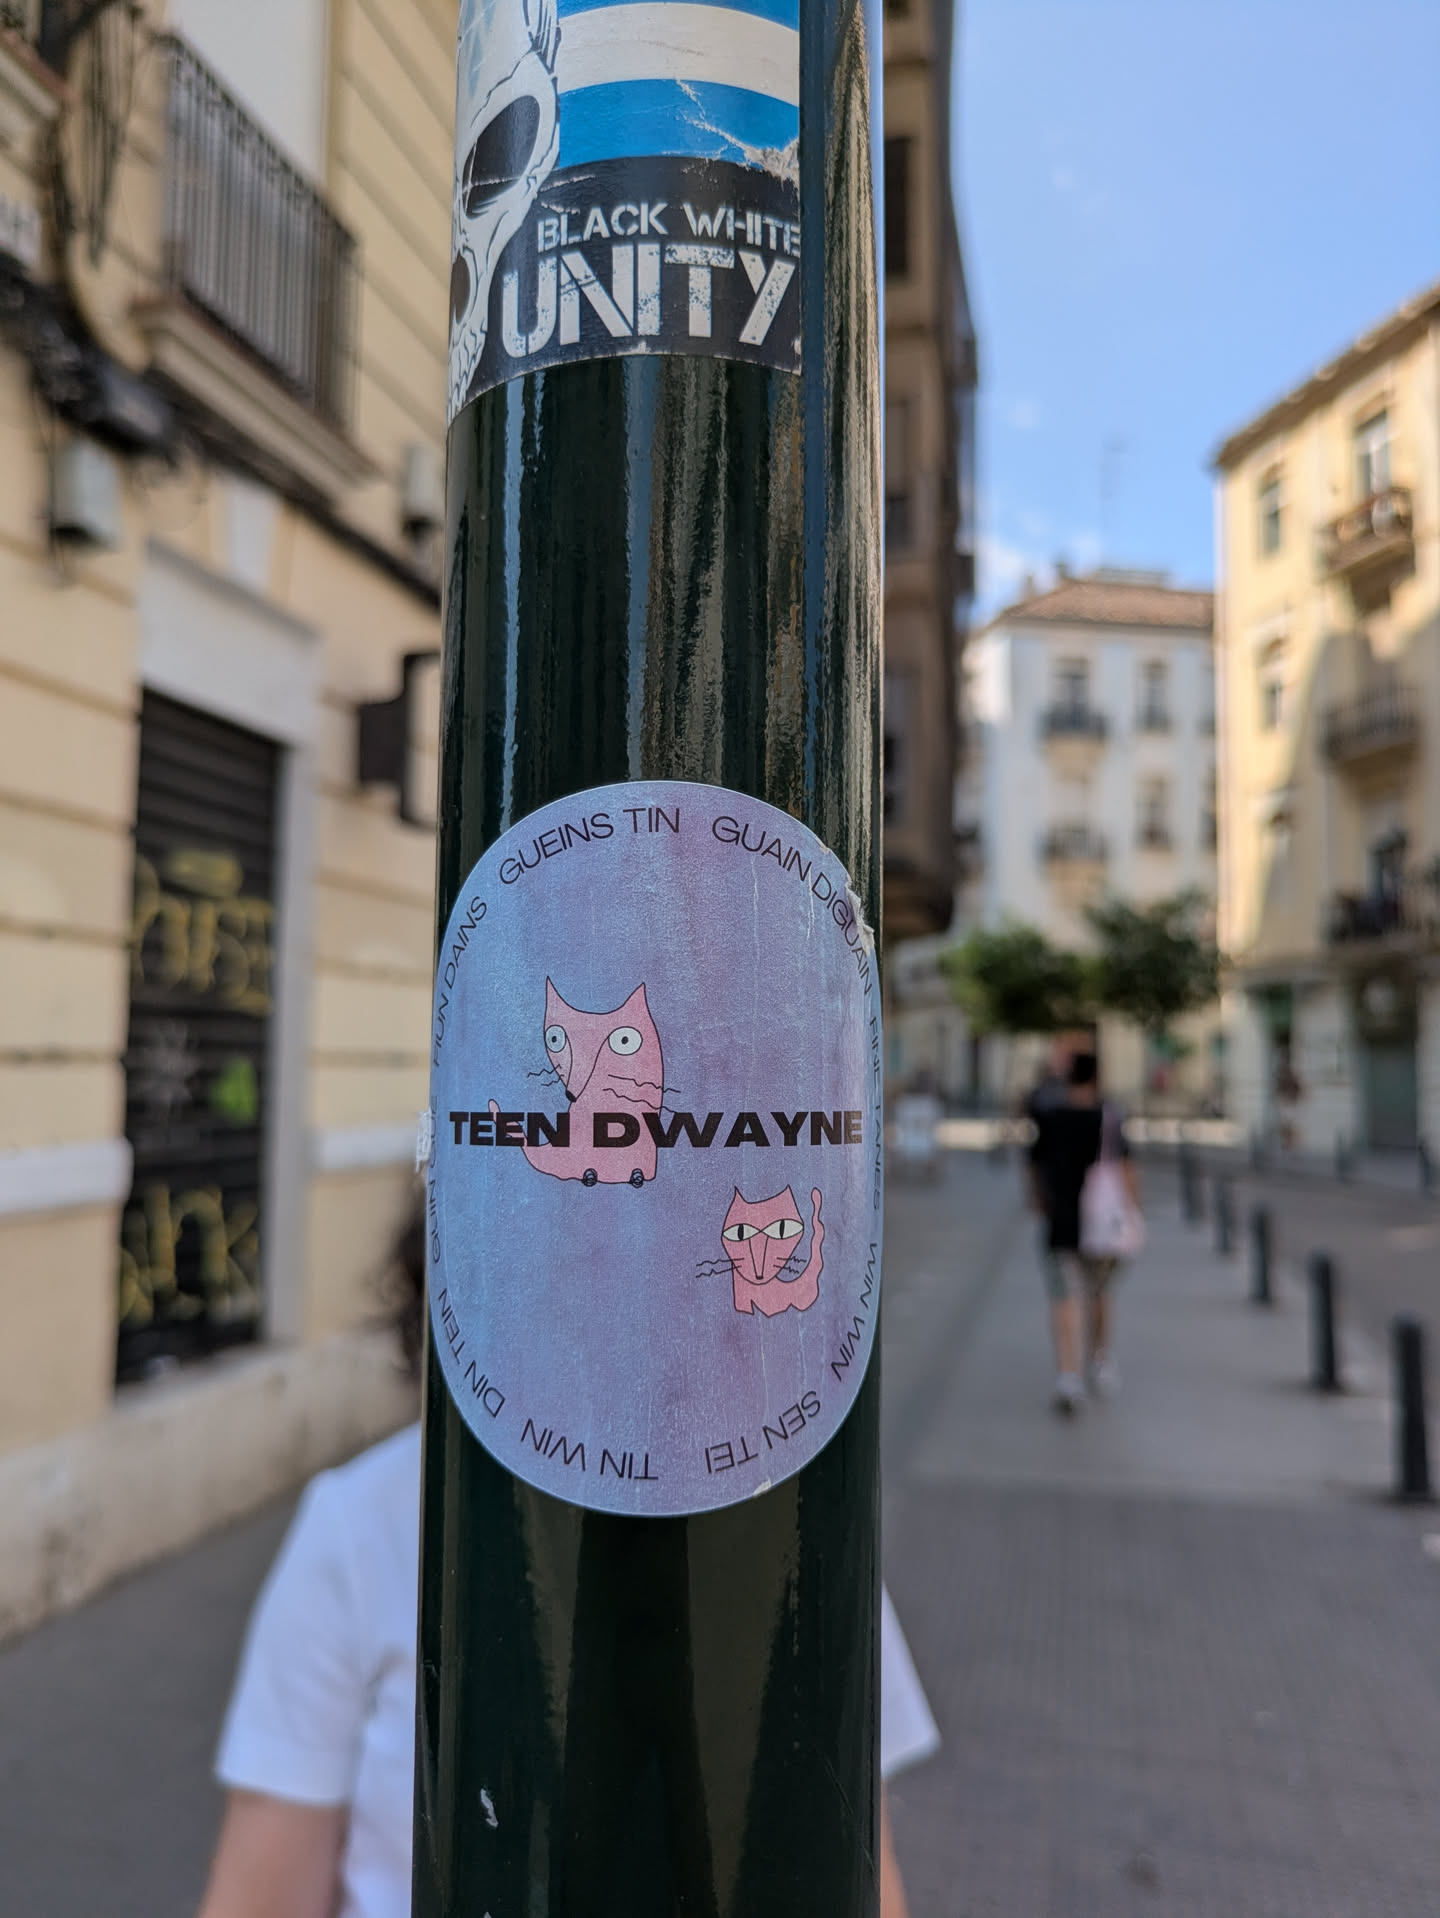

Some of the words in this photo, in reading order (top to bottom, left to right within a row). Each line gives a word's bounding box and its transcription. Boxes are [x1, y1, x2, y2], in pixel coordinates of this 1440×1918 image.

[537, 202, 668, 253] BLACK
[682, 203, 801, 259] WHITE
[499, 812, 614, 886] GUEINS
[623, 807, 680, 833] TIN
[711, 815, 812, 882] GUAIN
[811, 872, 873, 996] DIGUAIN
[444, 896, 488, 990] DAINS
[449, 1111, 571, 1148] TEEN
[592, 1111, 863, 1148] DWAYNE
[860, 1242, 878, 1309] WIN
[438, 1287, 466, 1366] TEIN
[830, 1315, 865, 1382] WIN
[464, 1359, 506, 1418] DIN
[520, 1418, 587, 1472] WIN
[762, 1390, 822, 1451] SEN
[600, 1448, 659, 1481] TIN
[704, 1436, 759, 1474] TEI
